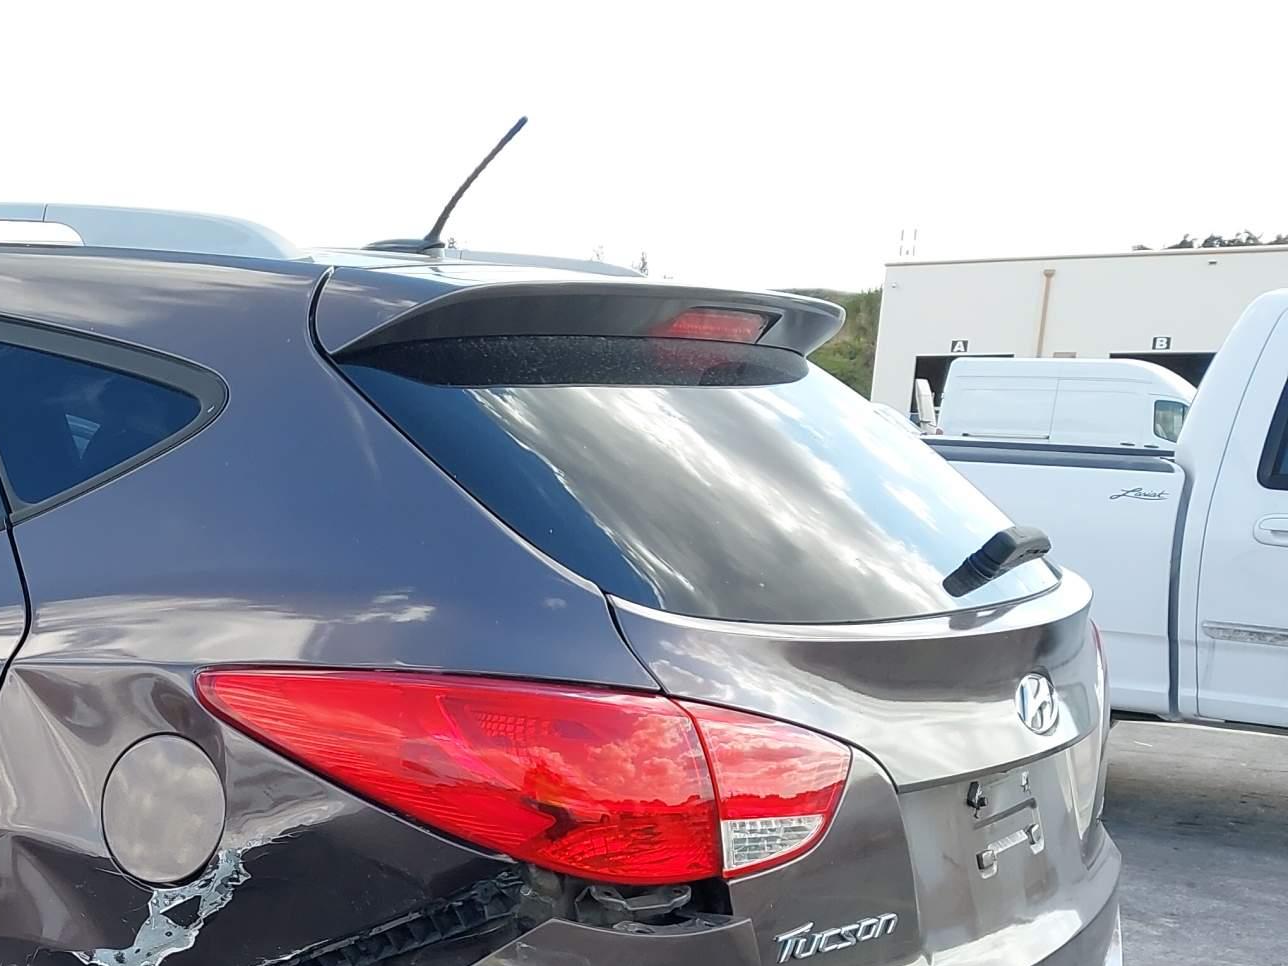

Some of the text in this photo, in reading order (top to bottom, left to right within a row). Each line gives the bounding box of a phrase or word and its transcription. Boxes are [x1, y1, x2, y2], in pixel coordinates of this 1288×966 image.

[953, 341, 968, 352] A
[1155, 337, 1170, 349] B
[1109, 487, 1169, 501] Lariat
